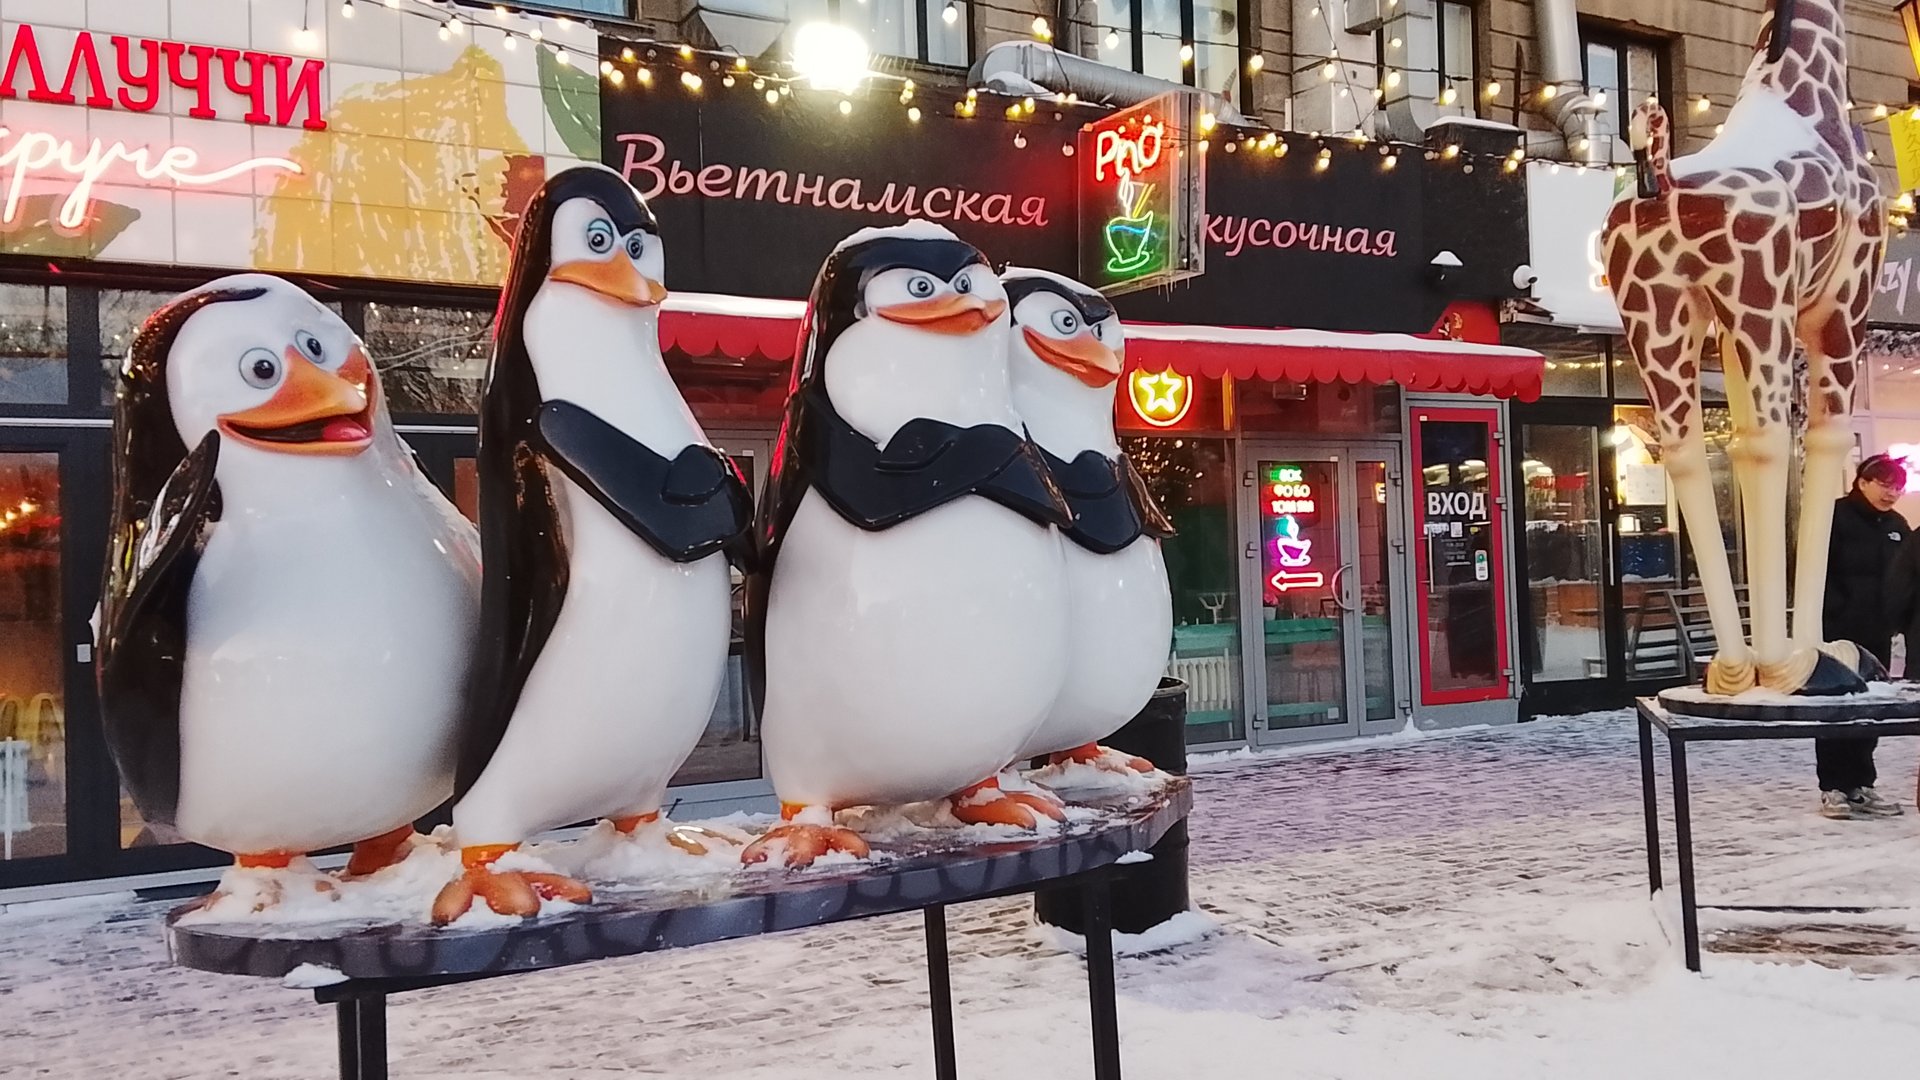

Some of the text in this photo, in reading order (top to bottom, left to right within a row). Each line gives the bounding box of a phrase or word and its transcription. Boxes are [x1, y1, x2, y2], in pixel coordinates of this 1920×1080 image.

[0, 126, 303, 228] руче
[616, 133, 1049, 227] Вьетнамская
[1427, 492, 1487, 520] ВХОД
